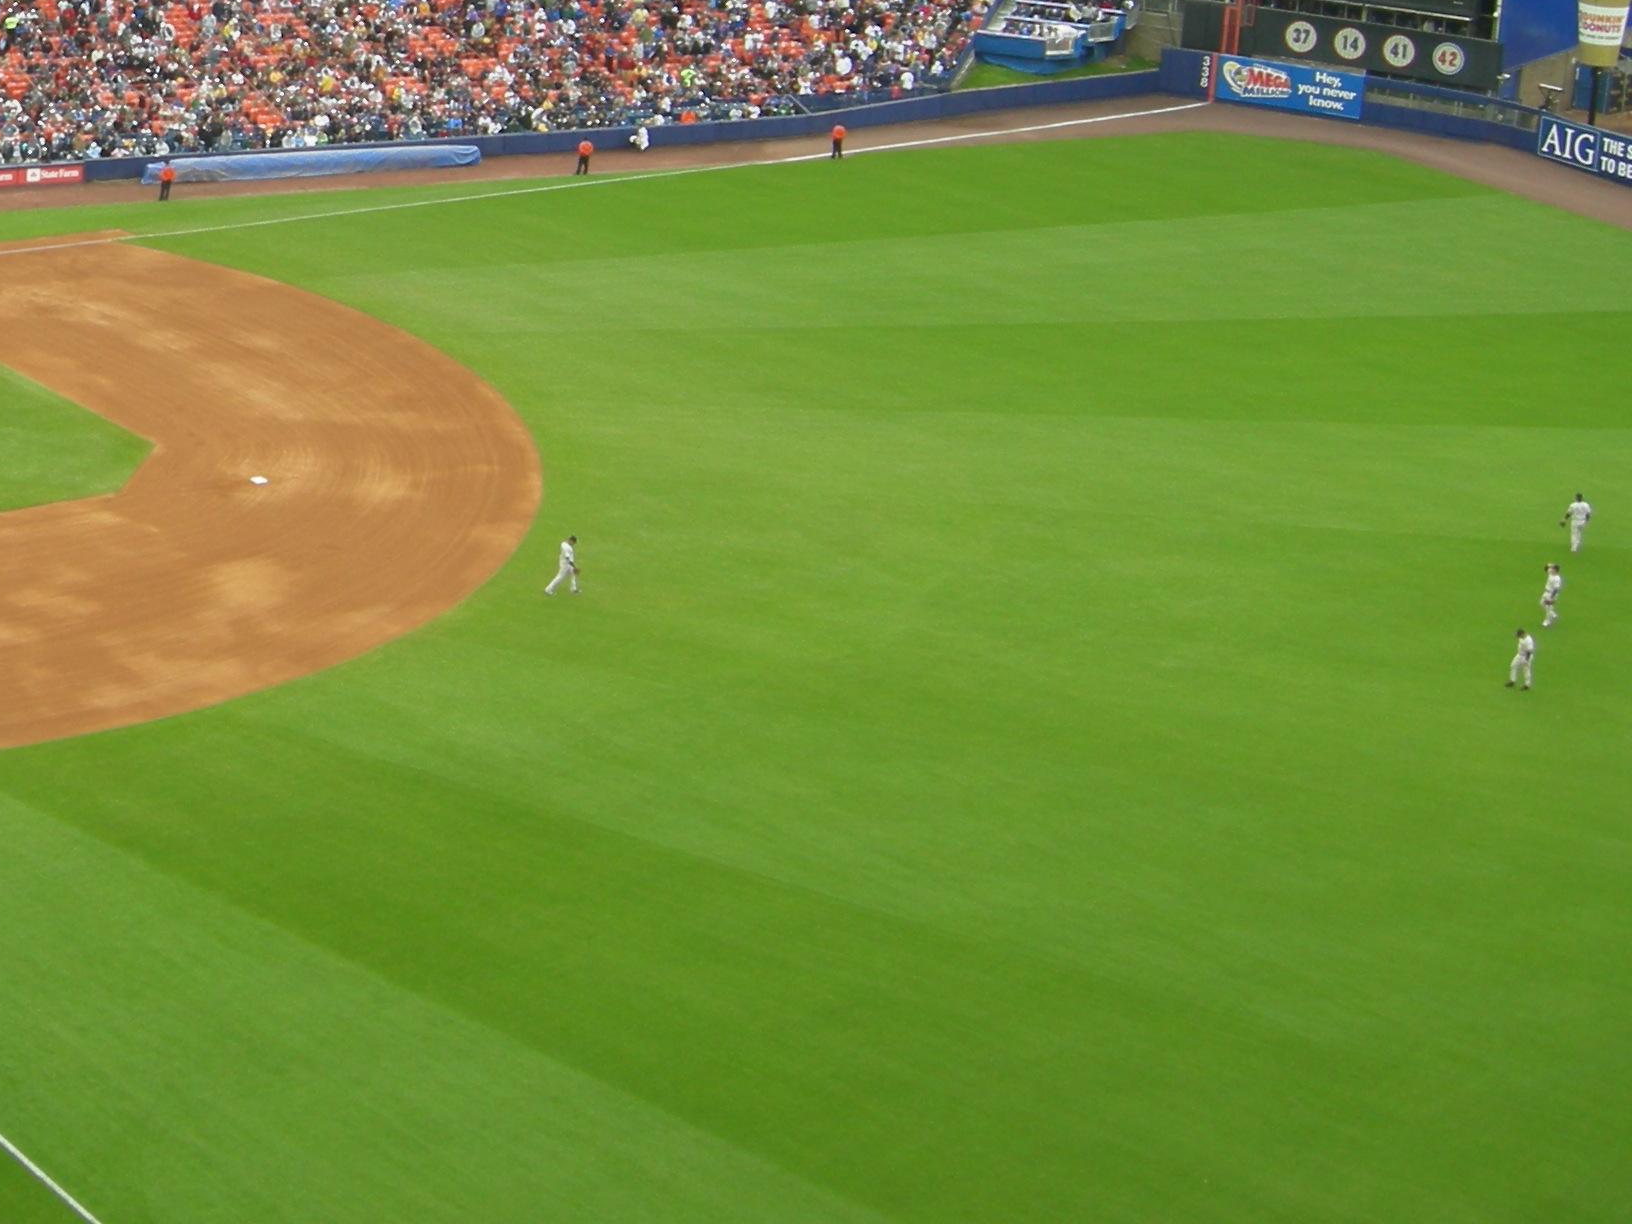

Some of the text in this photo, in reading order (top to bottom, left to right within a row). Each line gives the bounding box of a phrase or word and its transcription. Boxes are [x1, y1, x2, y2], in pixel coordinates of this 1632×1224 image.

[1292, 28, 1310, 45] 37
[1341, 34, 1359, 52] 14
[1389, 42, 1408, 59] 41
[1437, 49, 1458, 67] 42
[1316, 71, 1341, 87] Hey,
[1297, 82, 1356, 100] you never
[1541, 124, 1595, 166] AIG
[1602, 137, 1625, 157] THE
[41, 168, 79, 178] State Farm
[1600, 156, 1616, 174] TO
